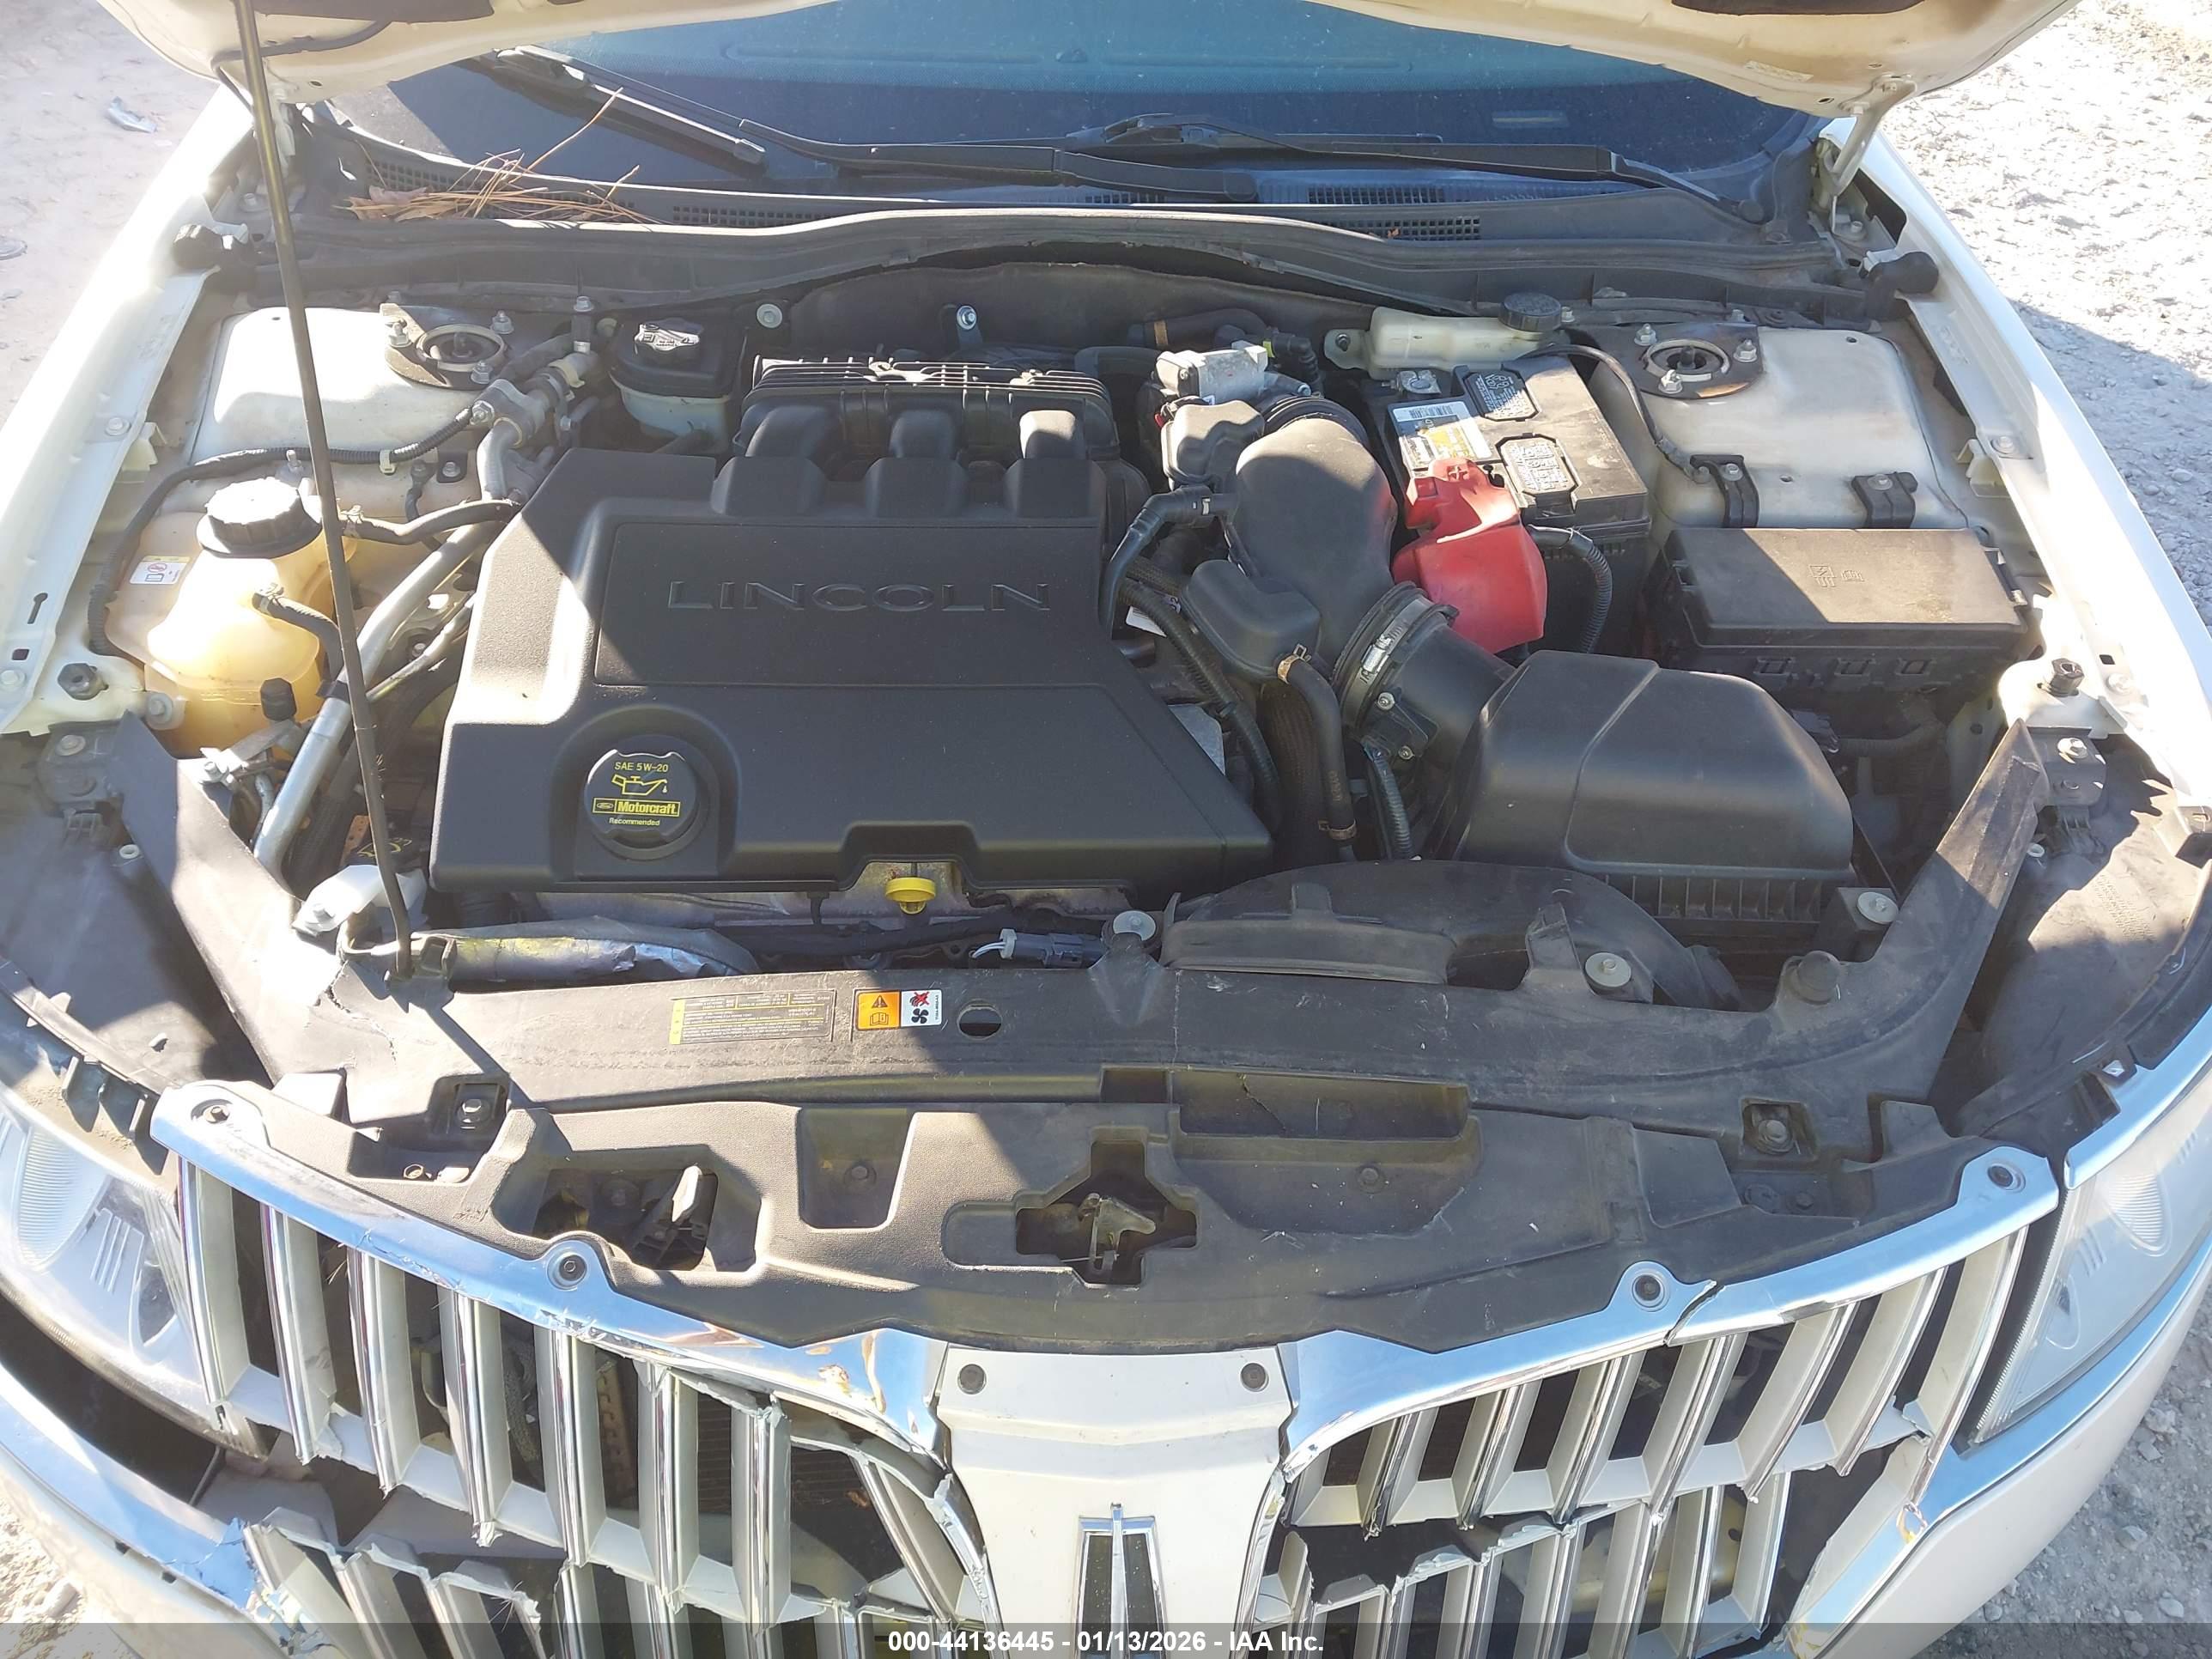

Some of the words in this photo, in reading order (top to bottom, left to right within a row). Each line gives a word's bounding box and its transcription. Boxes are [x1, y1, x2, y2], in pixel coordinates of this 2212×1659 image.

[667, 580, 1051, 612] LINCOLN
[614, 762, 634, 771] SAE
[636, 763, 669, 773] 5W-20
[618, 801, 678, 814] Motorcraft
[609, 817, 659, 826] Recommended
